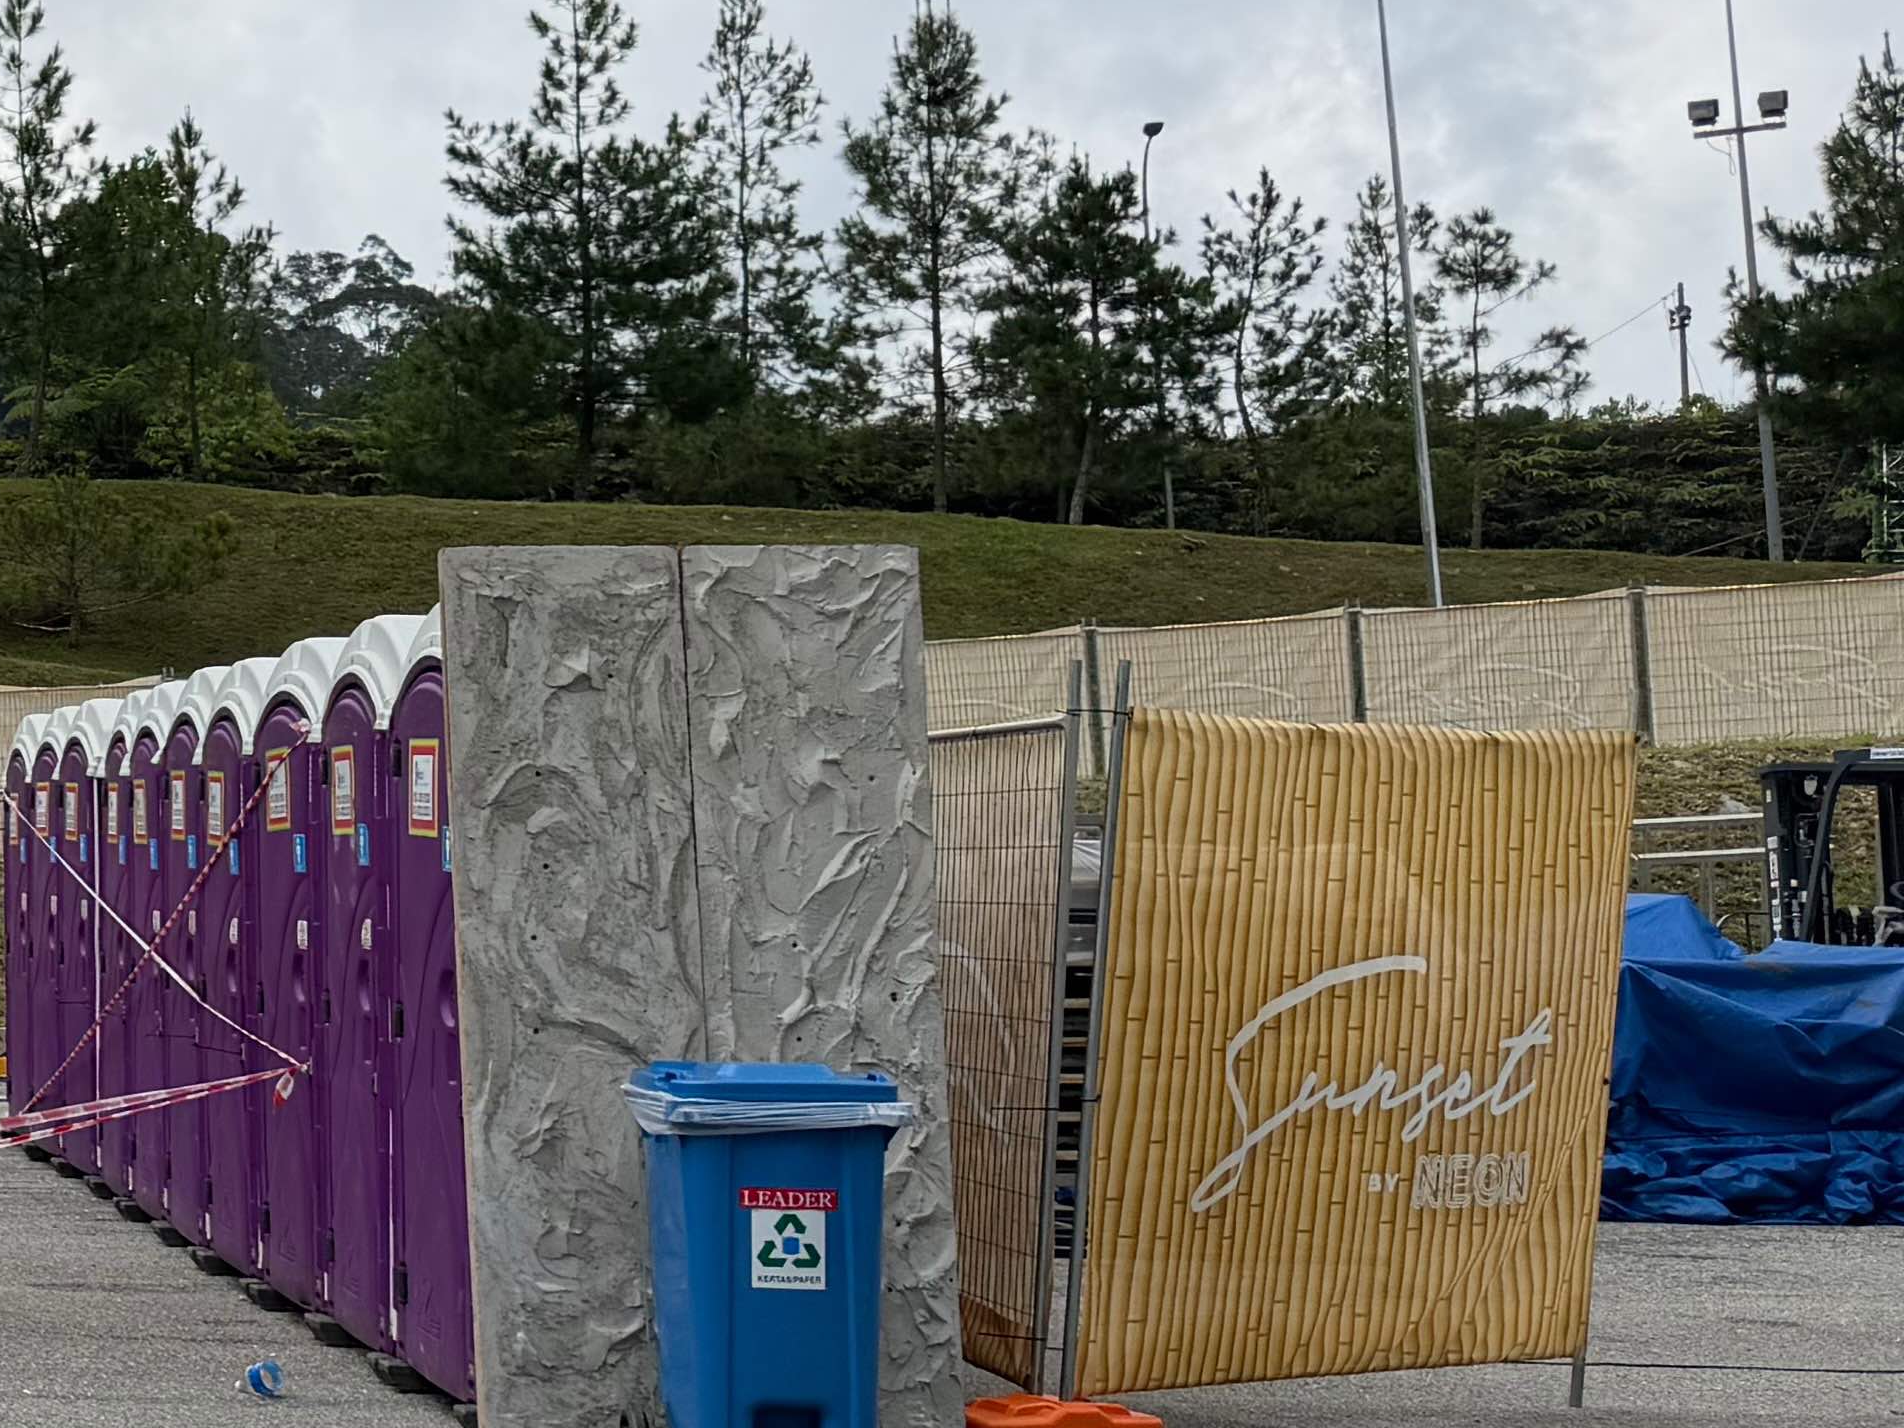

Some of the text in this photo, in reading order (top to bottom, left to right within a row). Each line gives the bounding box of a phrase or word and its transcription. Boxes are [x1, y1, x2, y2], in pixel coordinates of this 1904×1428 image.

[1191, 955, 1553, 1213] Sunset
[742, 1190, 833, 1208] LEADER
[1368, 1151, 1530, 1210] BY NEON
